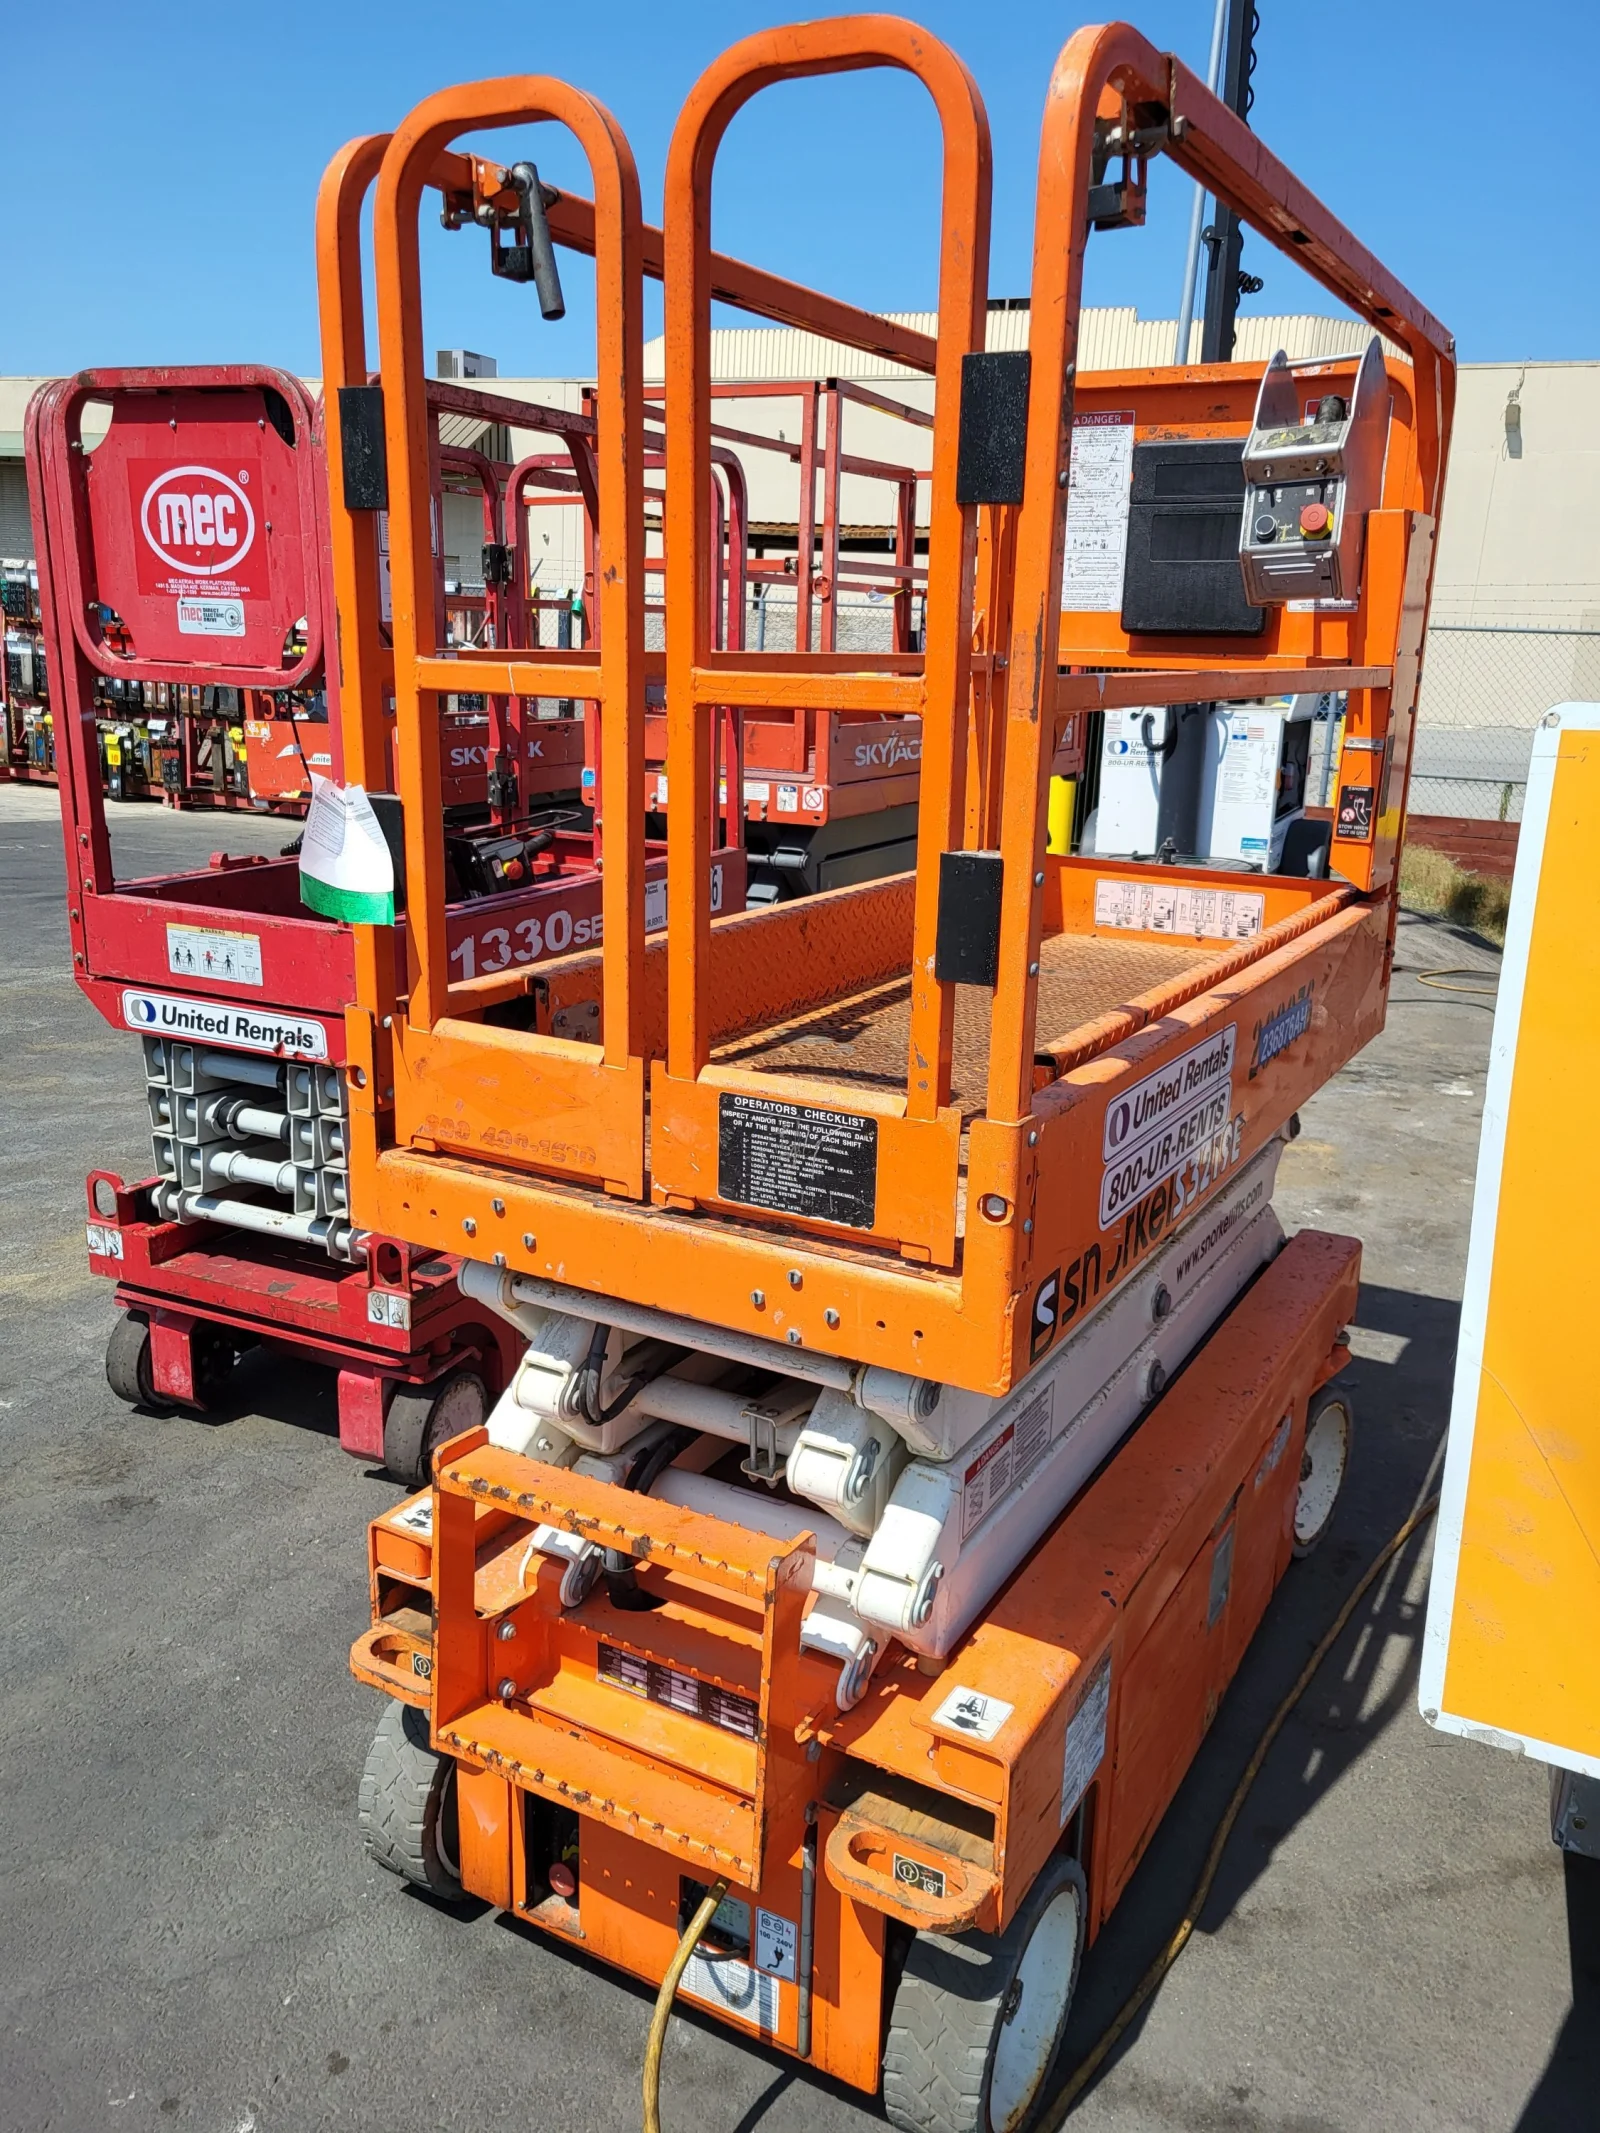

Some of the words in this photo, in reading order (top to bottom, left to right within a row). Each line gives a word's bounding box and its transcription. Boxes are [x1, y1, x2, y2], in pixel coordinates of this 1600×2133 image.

[1082, 414, 1121, 424] DANGER
[162, 1004, 229, 1035] United
[235, 1016, 314, 1049] Rentals
[1133, 1067, 1183, 1129] United
[1183, 1039, 1230, 1094] Rentals
[722, 1109, 748, 1120] INSPECT
[752, 1115, 776, 1125] AND/OR
[778, 1119, 795, 1128] TEST
[812, 1125, 852, 1139] FOLLOWING
[855, 1134, 874, 1142] DAILY
[734, 1096, 797, 1116] OPERATORS
[805, 1109, 865, 1128] CHECKLIST
[751, 1133, 776, 1142] OPERATING
[792, 1141, 820, 1150] EMERGENCY
[756, 1123, 767, 1131] THE
[809, 1132, 818, 1140] OF
[821, 1134, 839, 1144] EACH
[843, 1139, 862, 1148] SHIFT
[751, 1145, 775, 1154] PERSONAL
[1108, 1092, 1226, 1211] 800-UR-RENTS
[762, 1182, 788, 1191] OPERATING
[805, 1186, 827, 1194] CONTROL
[1176, 1180, 1263, 1284] www.snorkellifts.com
[980, 1436, 1004, 1466] DANGER
[759, 1930, 770, 1940] 100
[776, 1939, 793, 1949] 240V
